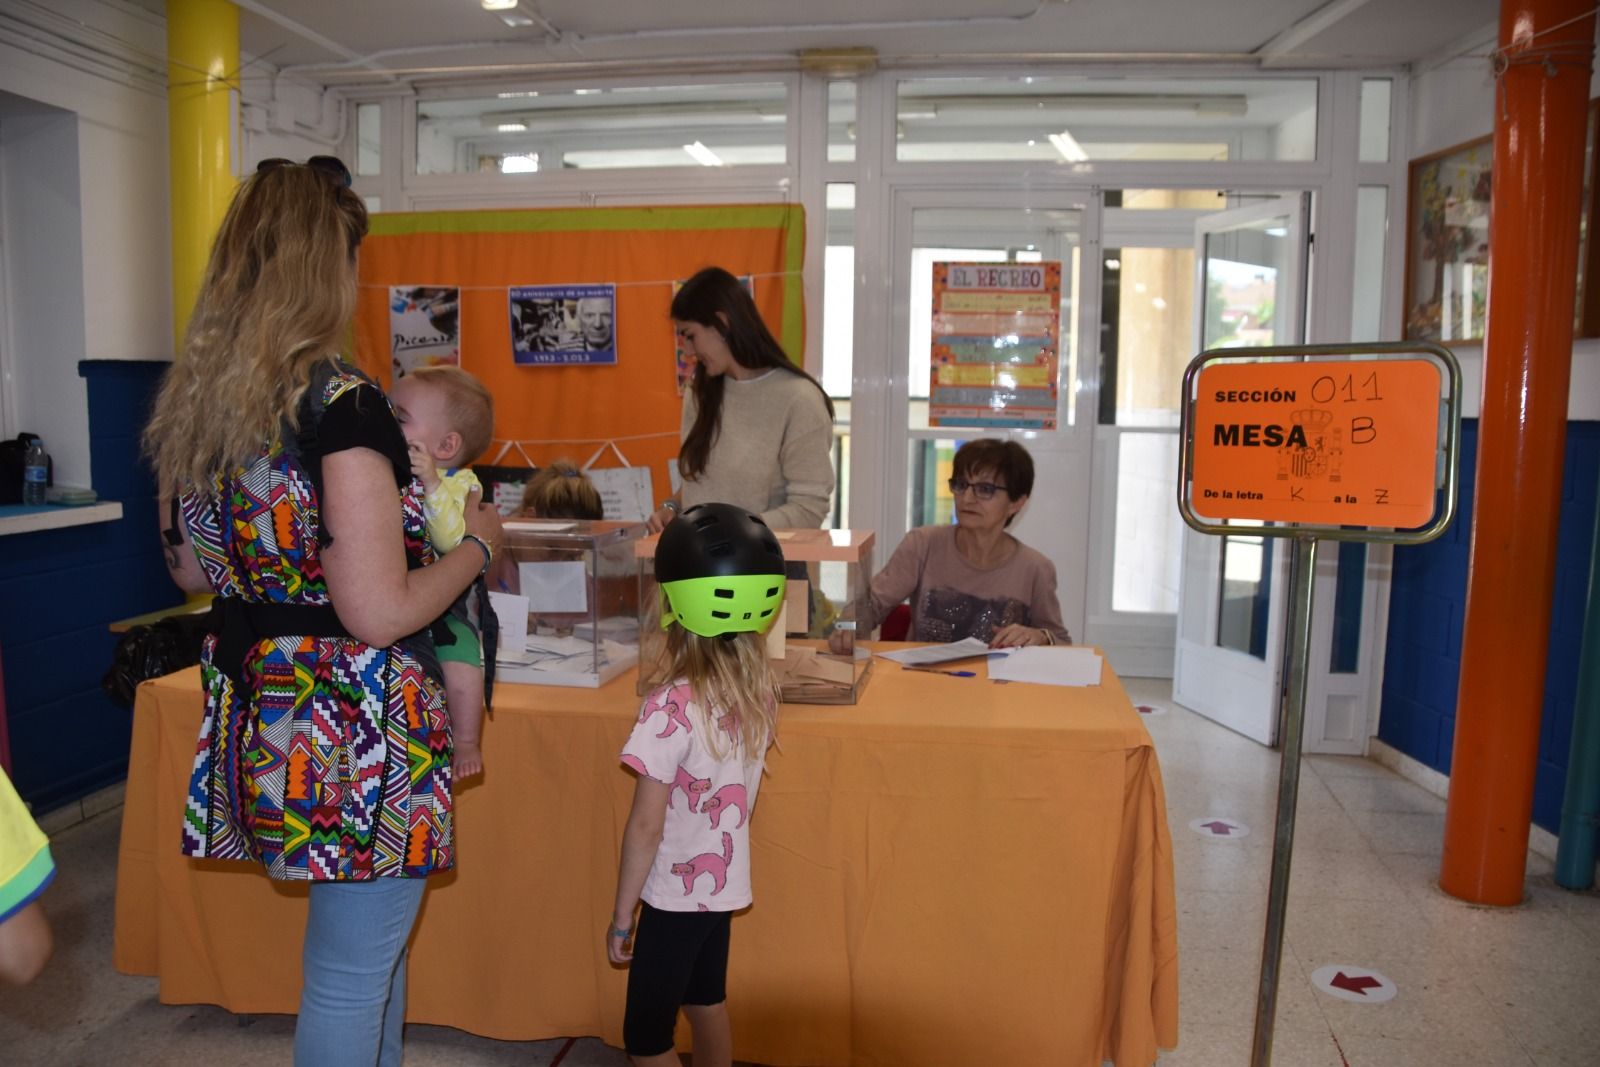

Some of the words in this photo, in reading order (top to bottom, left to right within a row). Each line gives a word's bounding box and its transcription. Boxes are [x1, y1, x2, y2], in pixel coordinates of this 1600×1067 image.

[953, 269, 972, 287] EL
[977, 268, 1041, 288] RECREO
[1215, 387, 1296, 402] SECCIÓN
[1311, 371, 1383, 403] 011
[1213, 424, 1308, 448] MESA
[1351, 416, 1377, 444] B
[1204, 489, 1219, 498] De
[1222, 489, 1233, 499] la
[1236, 490, 1264, 500] letra
[1291, 486, 1305, 501] K
[1334, 495, 1342, 503] a
[1345, 494, 1358, 504] la
[1374, 488, 1389, 504] Z
